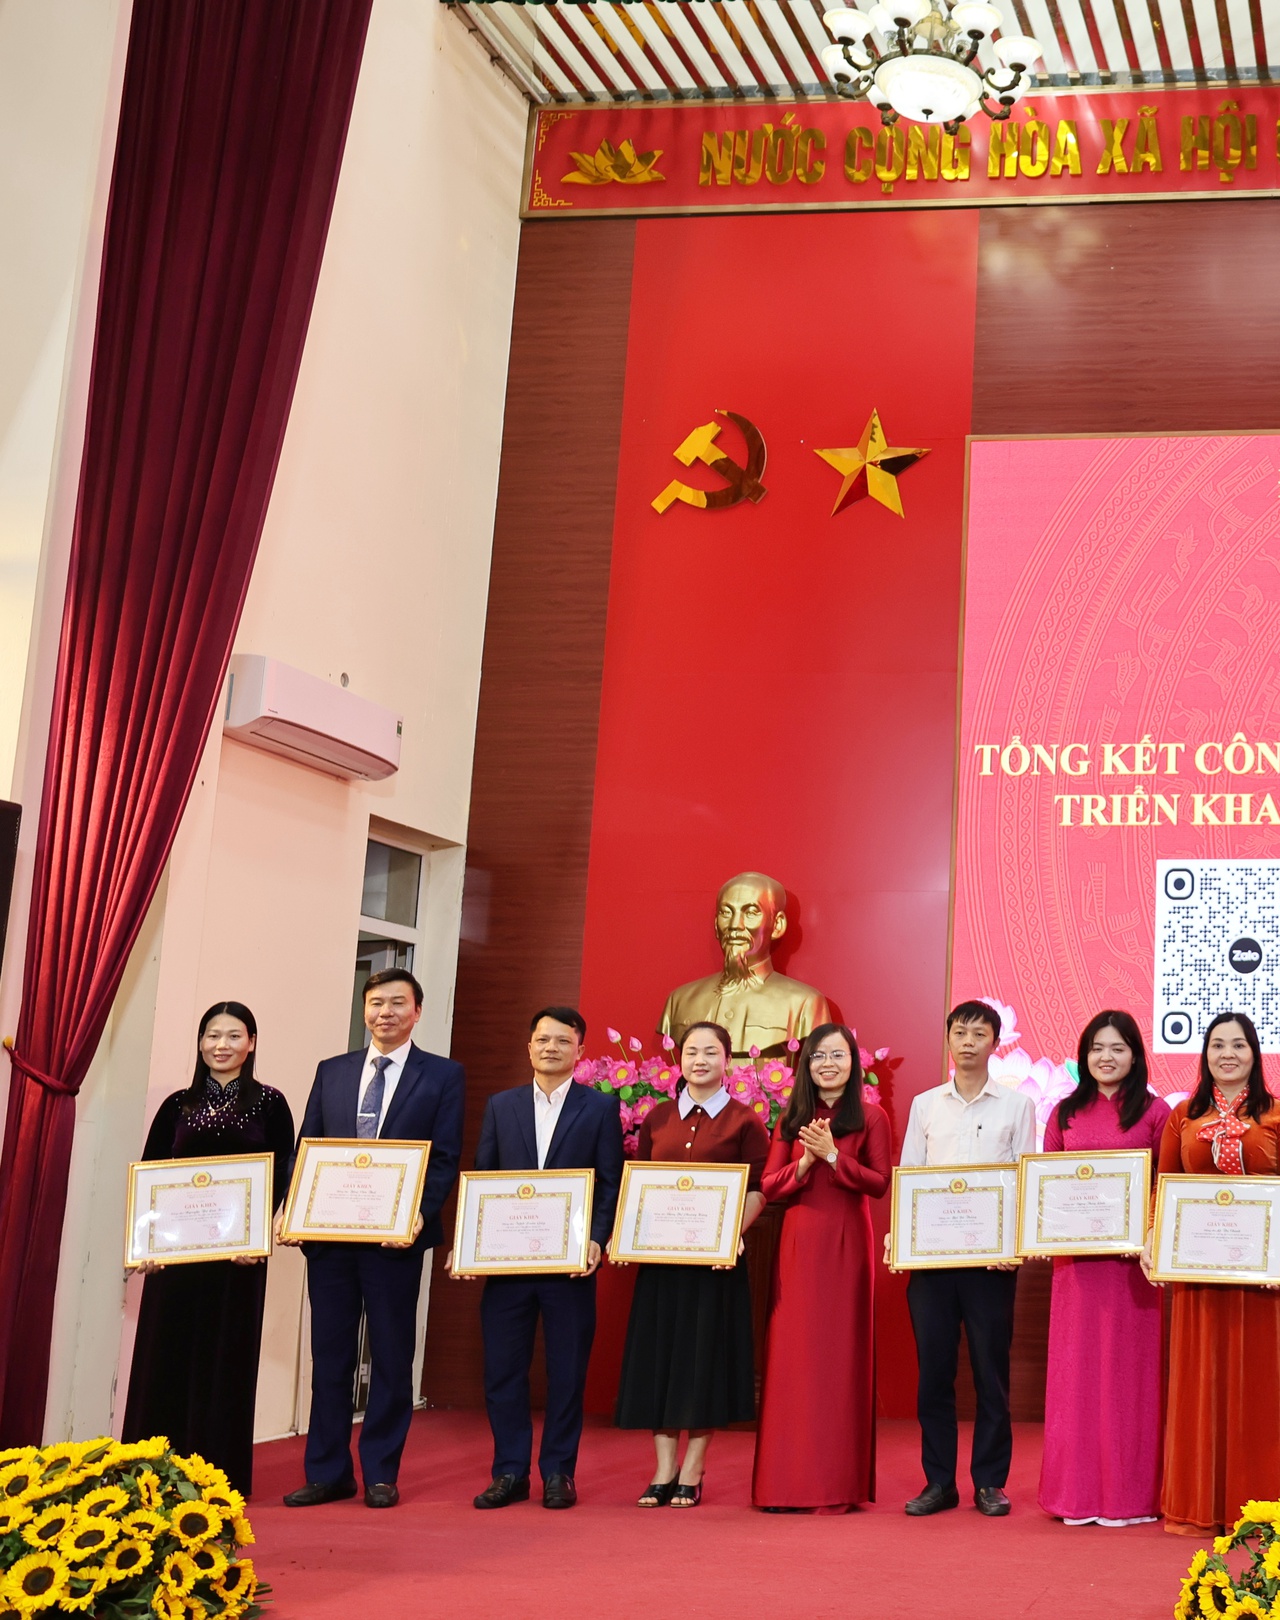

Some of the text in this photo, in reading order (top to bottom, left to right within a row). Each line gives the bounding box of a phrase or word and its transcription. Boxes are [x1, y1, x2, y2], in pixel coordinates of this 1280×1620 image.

[699, 111, 827, 186] NƯỚC
[986, 105, 1083, 179] HÒA
[1096, 104, 1162, 175] XÃ
[1178, 99, 1258, 182] HỘI
[974, 733, 1092, 776] TỔNG
[1100, 733, 1185, 775] KẾT
[1055, 783, 1180, 827] TRIỂN
[1232, 949, 1260, 962] Zalo
